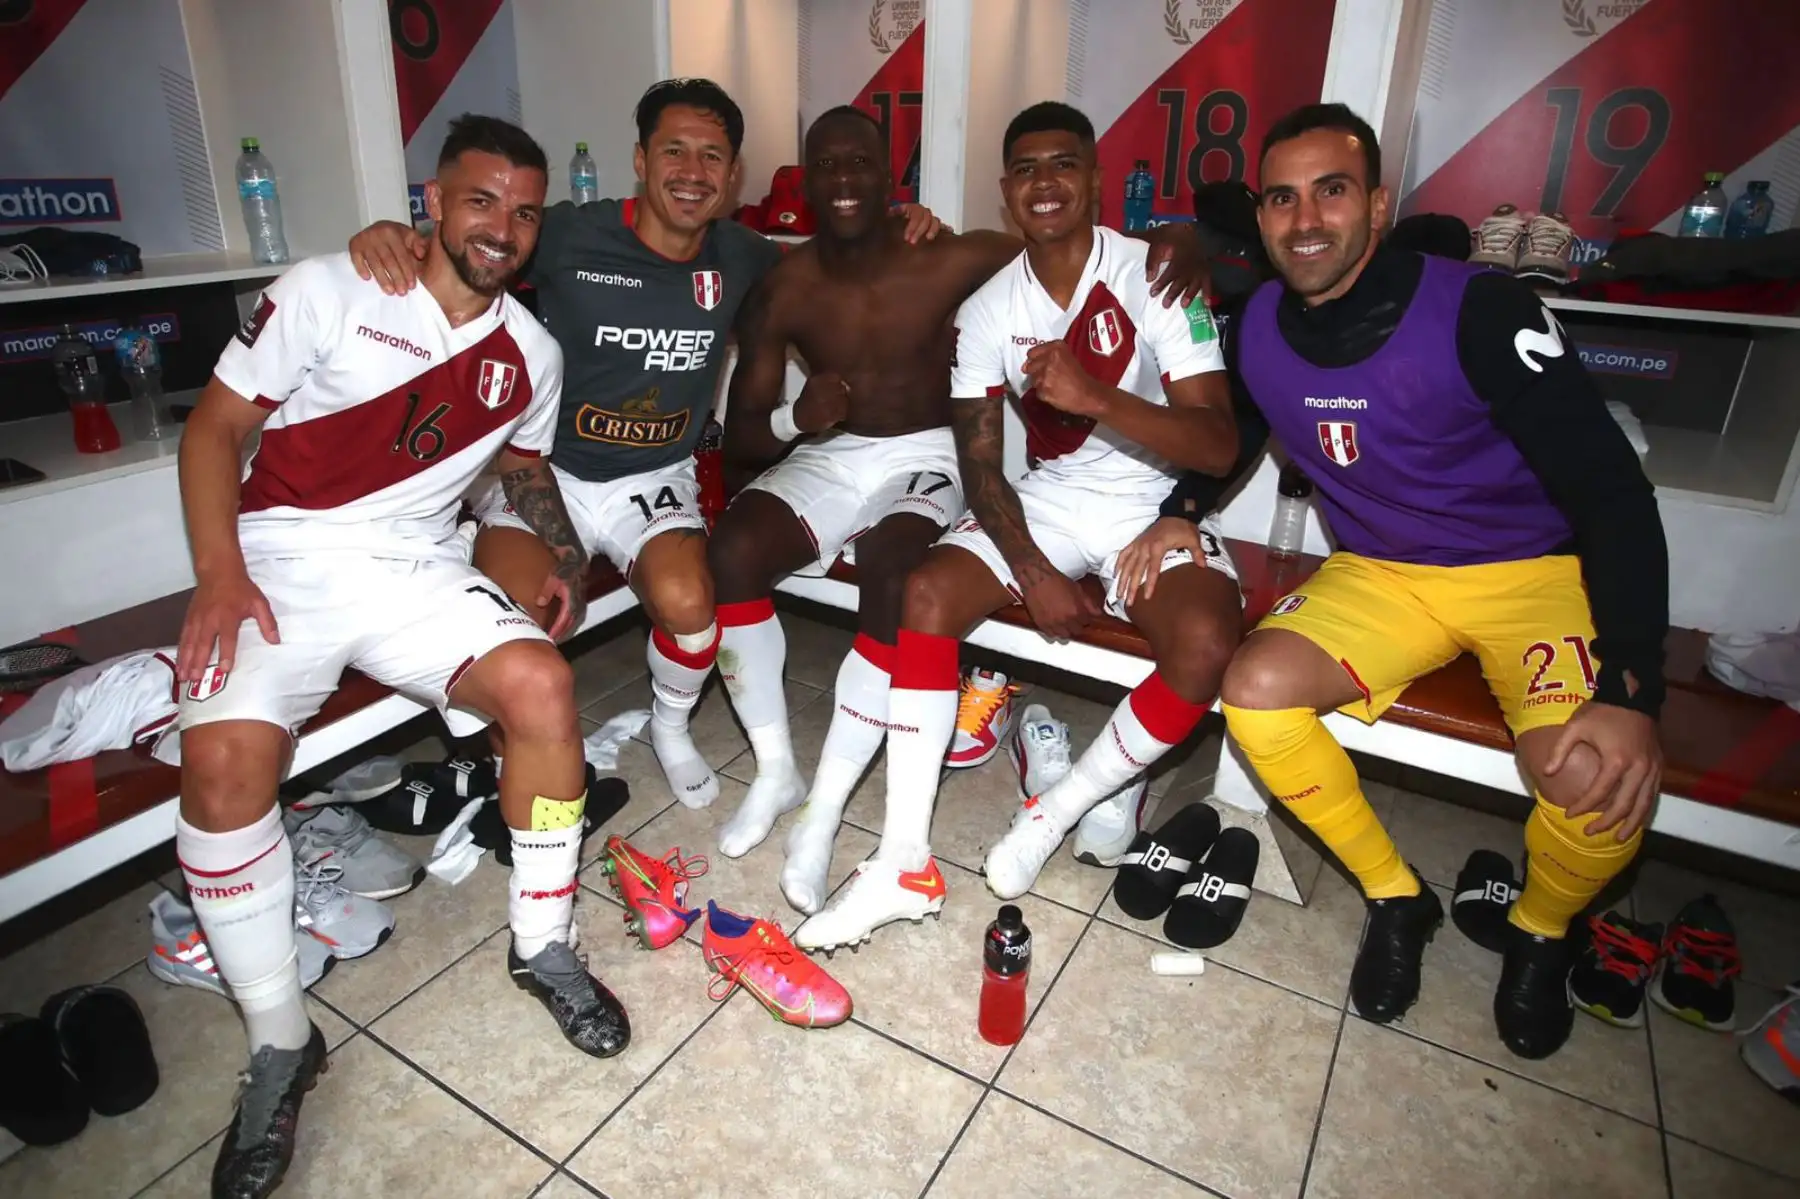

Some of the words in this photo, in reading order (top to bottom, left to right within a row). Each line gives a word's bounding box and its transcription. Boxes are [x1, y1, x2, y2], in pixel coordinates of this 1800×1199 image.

[1157, 88, 1249, 199] 18
[1539, 86, 1672, 220] 19
[577, 270, 643, 288] marathon
[356, 323, 432, 361] marathon
[594, 325, 715, 351] POWER
[644, 351, 708, 372] ADE
[1304, 396, 1368, 409] marathon
[391, 391, 453, 462] 16
[906, 471, 953, 496] 17
[629, 485, 684, 522] 14
[1521, 635, 1598, 696] 21
[1140, 841, 1170, 872] 18
[1194, 872, 1225, 902] 18
[1483, 879, 1511, 905] 19
